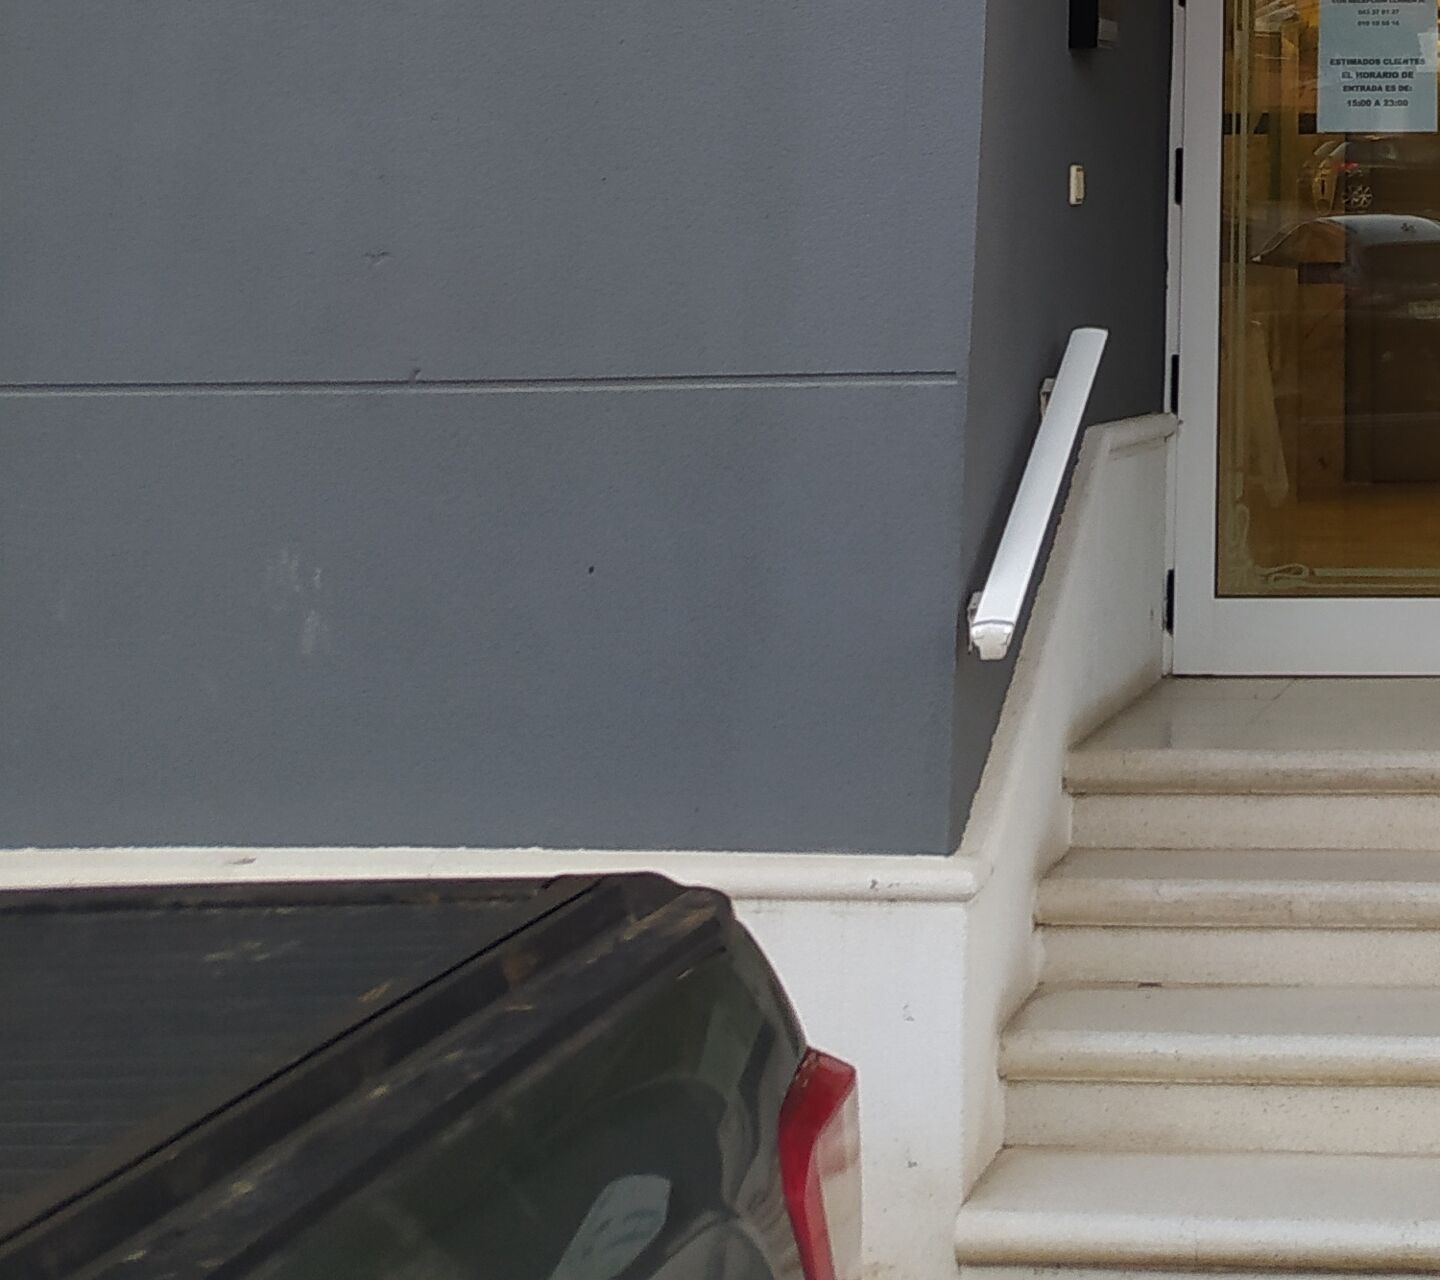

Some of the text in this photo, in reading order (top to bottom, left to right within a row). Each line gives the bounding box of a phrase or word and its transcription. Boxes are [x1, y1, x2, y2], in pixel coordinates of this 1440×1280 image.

[1341, 71, 1414, 79] EL HORARIO DE
[1342, 84, 1383, 92] ENTRADA
[1385, 84, 1396, 92] ES
[1374, 99, 1381, 107] A
